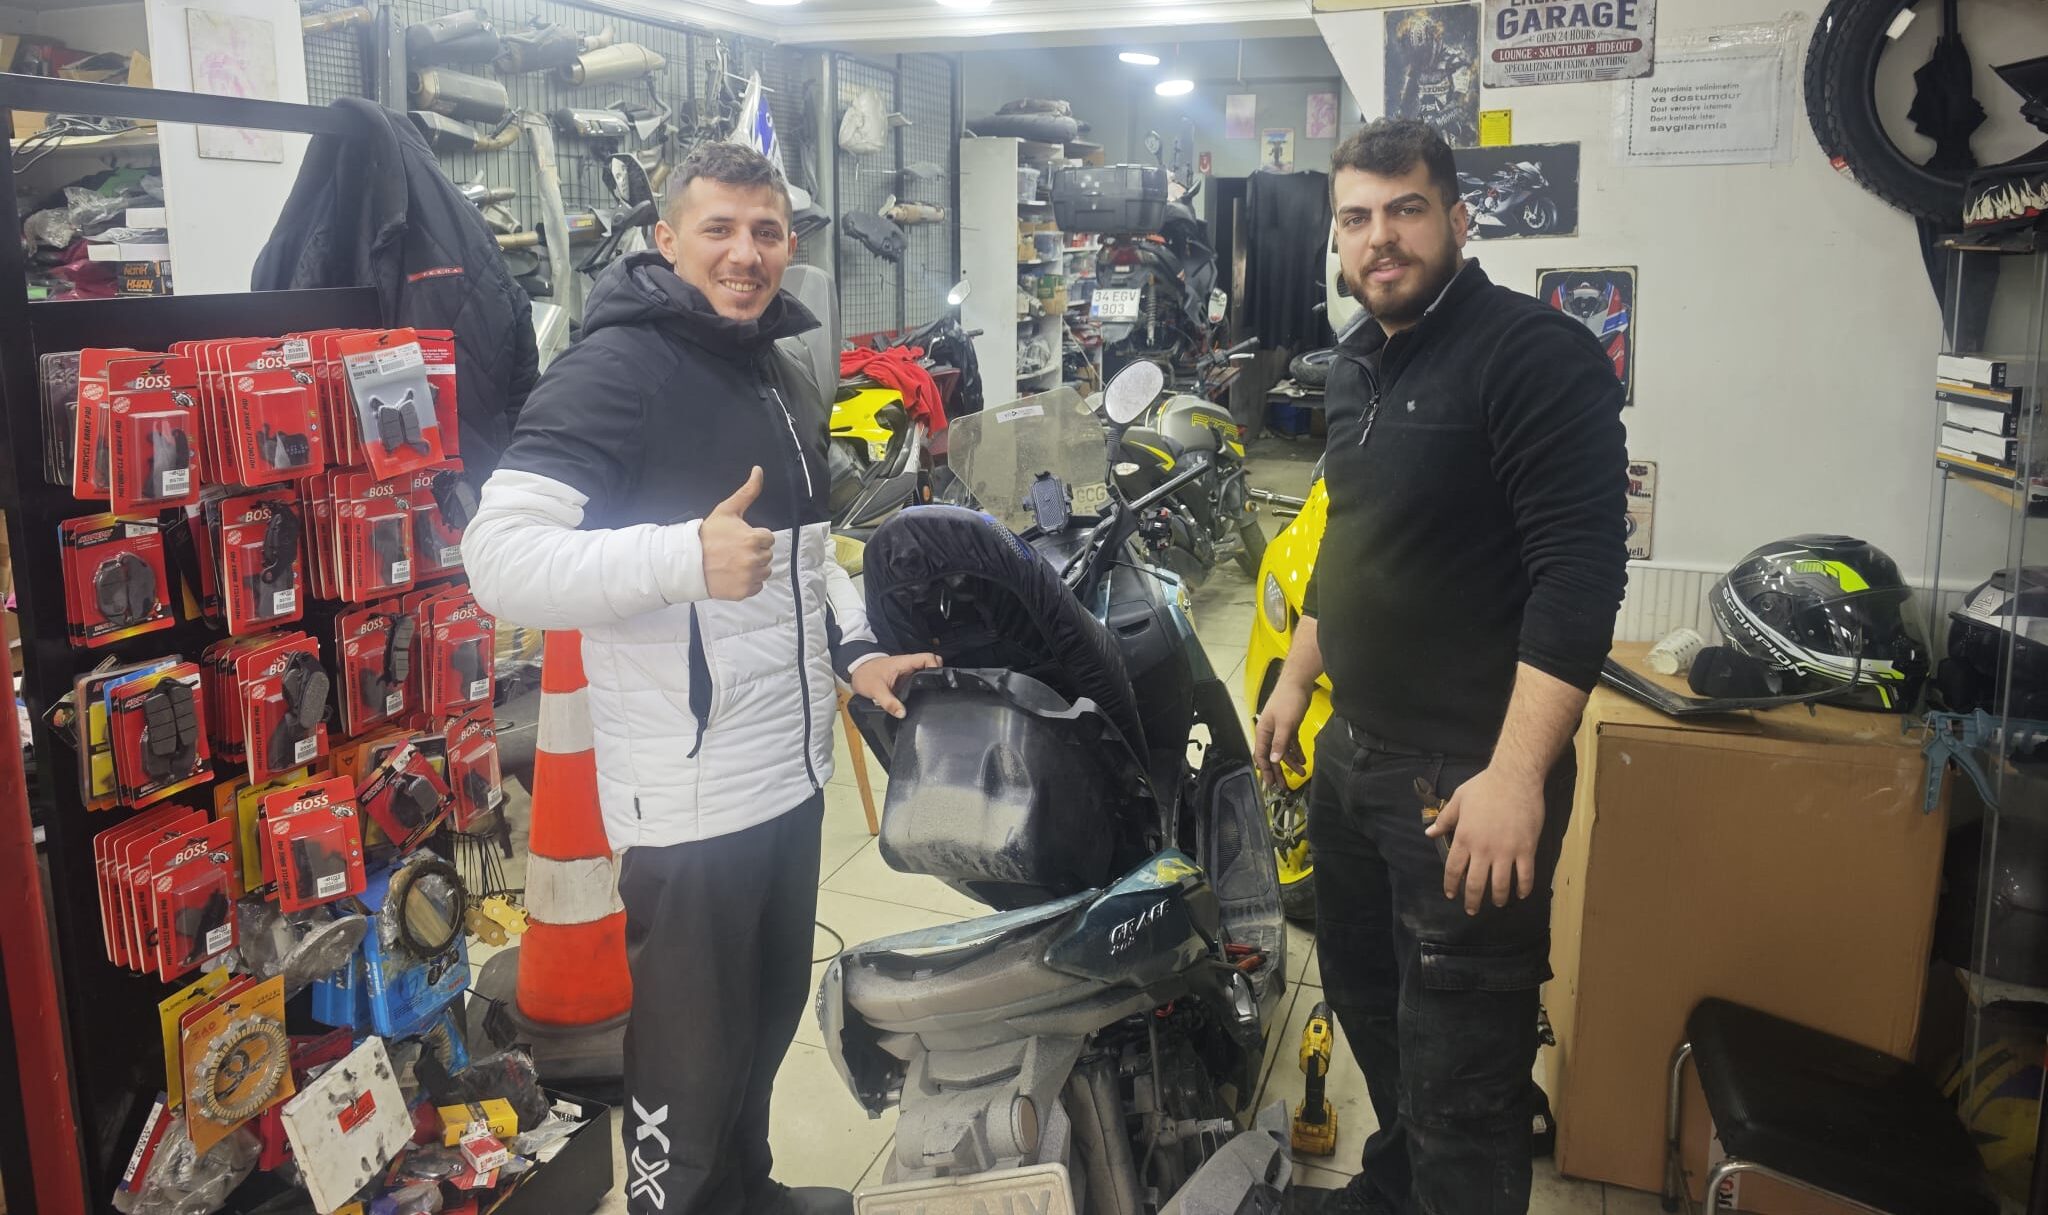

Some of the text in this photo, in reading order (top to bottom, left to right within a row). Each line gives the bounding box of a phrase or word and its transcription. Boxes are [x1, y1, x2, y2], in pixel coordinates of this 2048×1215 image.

[1496, 0, 1638, 40] GARAGE
[1536, 30, 1596, 43] OPEN 24 HOURS
[1500, 41, 1634, 60] LOUNGE SANCTUARY HIDEOUT
[1504, 56, 1628, 73] SPECIALIZING IN FIXING ANYTHING
[1537, 70, 1593, 82] EXCEPT STUPID
[1671, 93, 1742, 102] dostumdur
[1095, 292, 1137, 302] 34 EGV
[1102, 304, 1125, 314] 903
[135, 375, 172, 390] BOSS
[368, 485, 394, 498] BOSS
[452, 607, 478, 621] BOSS
[360, 617, 384, 634] BOSS
[1722, 587, 1807, 676] SCORPION
[268, 662, 286, 676] BO
[461, 722, 480, 740] BOSS
[294, 795, 328, 812] BOSS
[175, 841, 208, 865] BOSS
